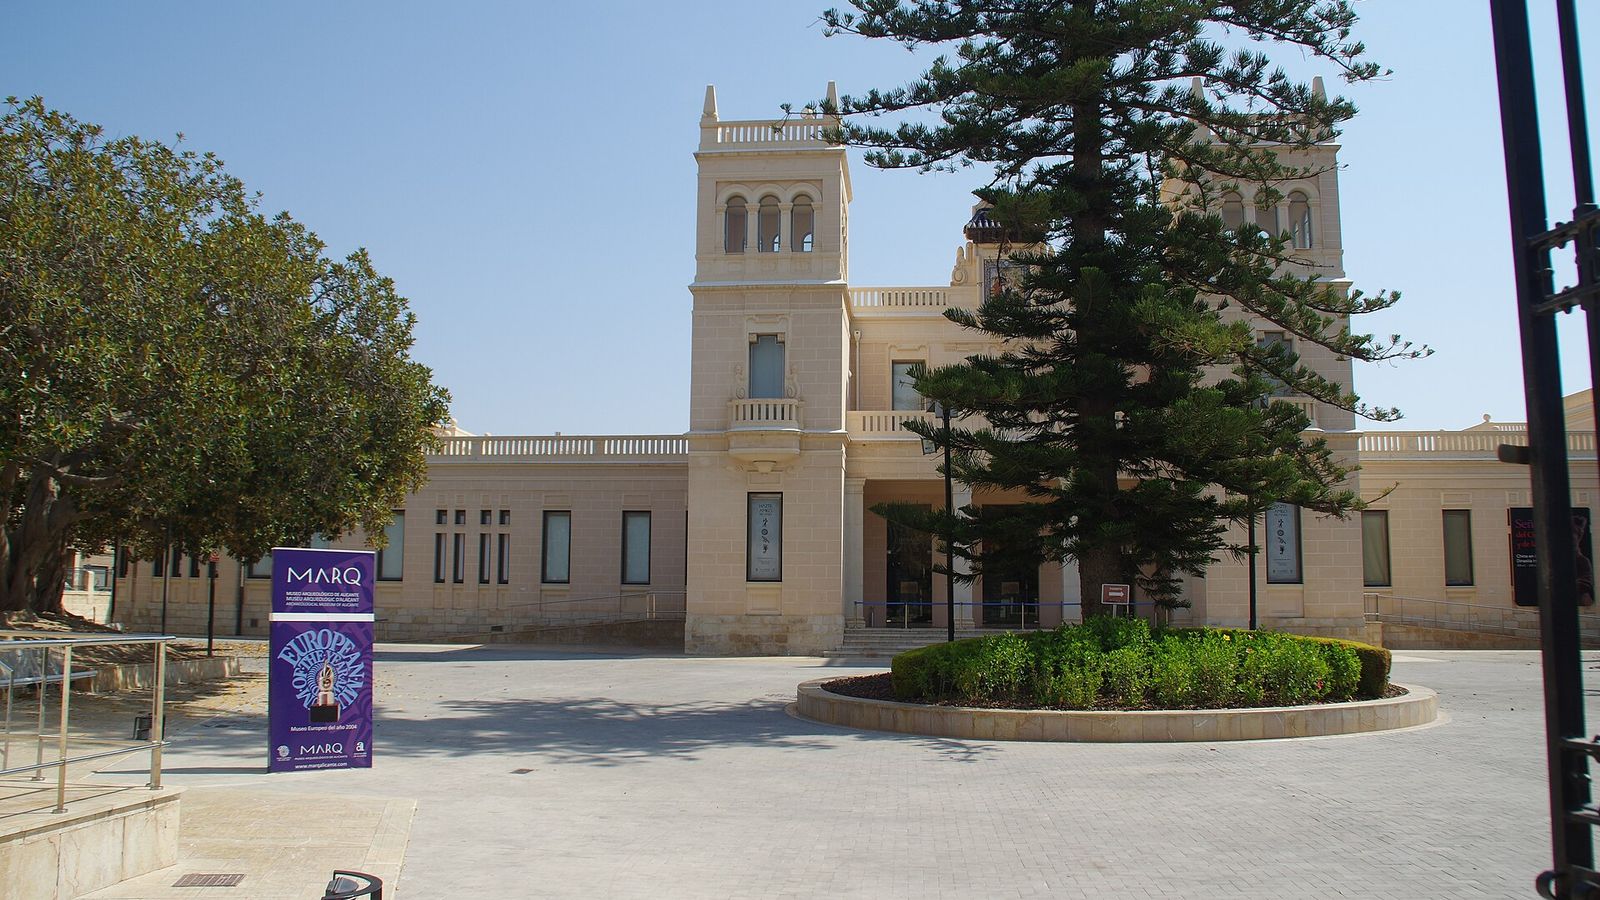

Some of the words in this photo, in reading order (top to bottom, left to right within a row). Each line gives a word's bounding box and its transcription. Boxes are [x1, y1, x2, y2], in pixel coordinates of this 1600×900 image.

[288, 567, 361, 586] MARQ
[277, 628, 365, 678] EUROPEAN
[298, 650, 325, 671] THE
[300, 742, 343, 755] MARQ
